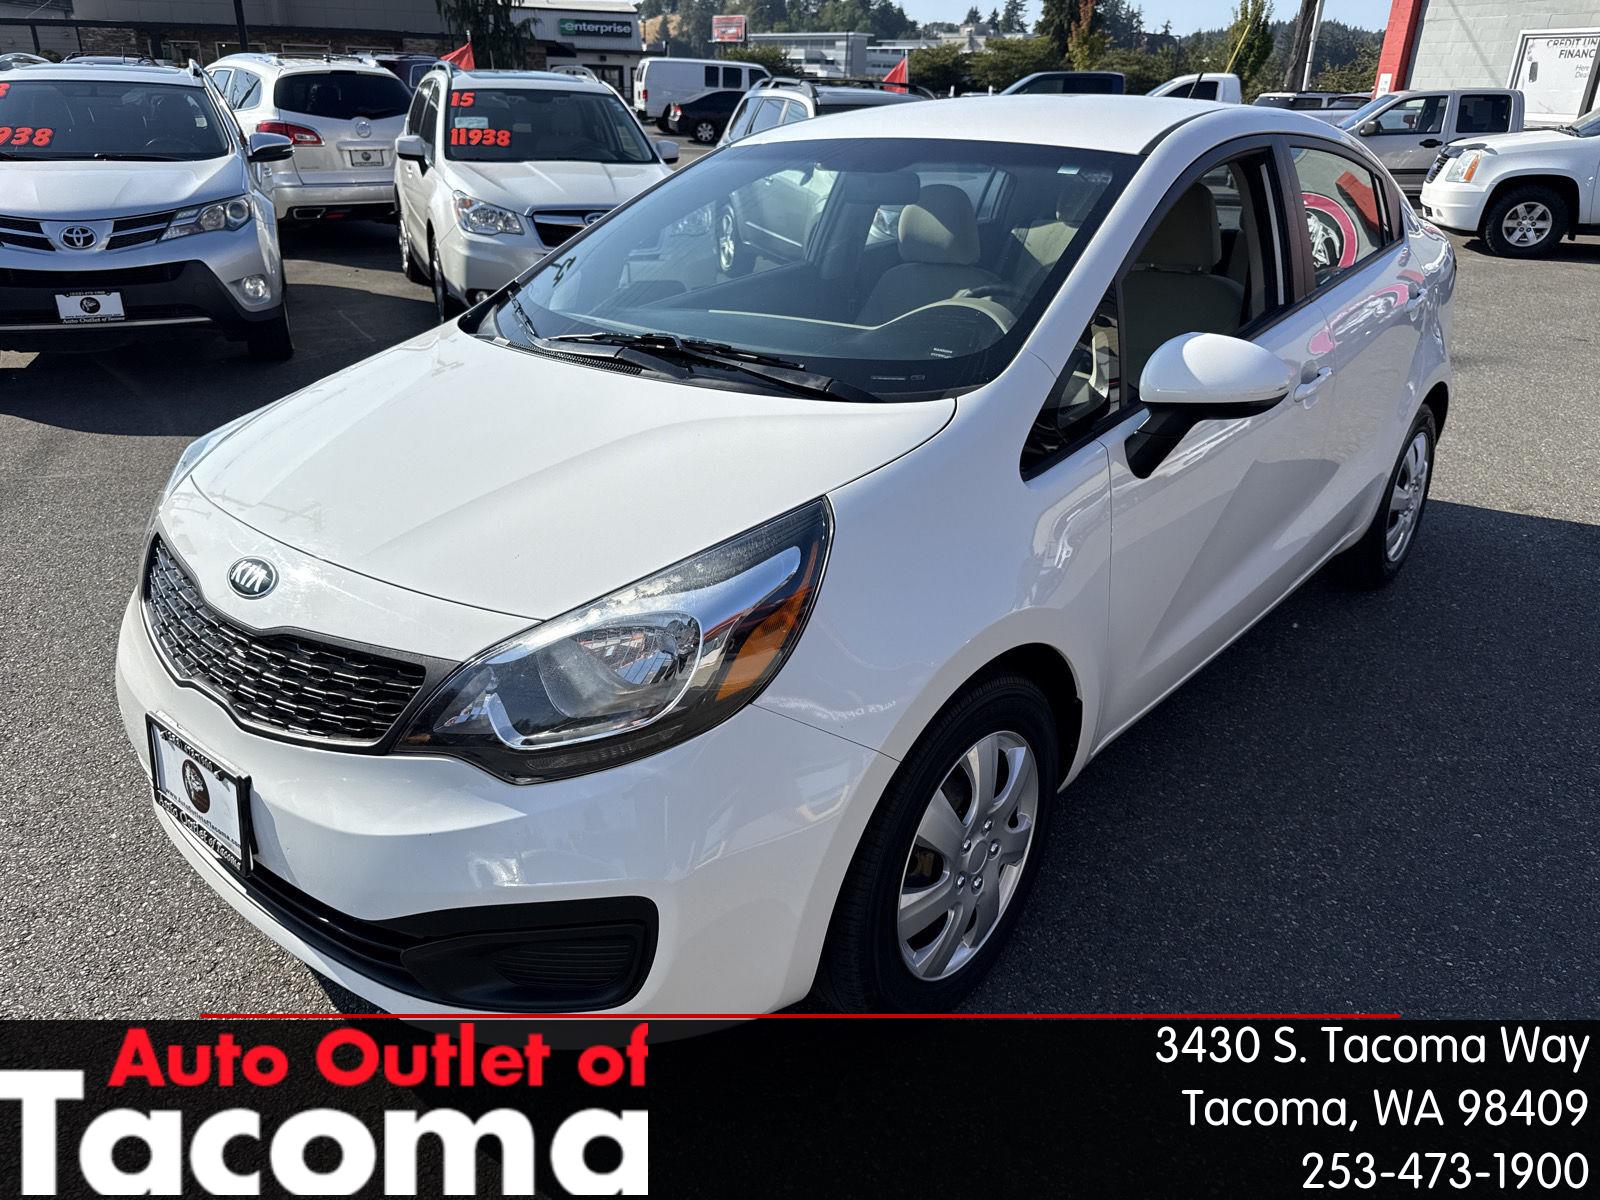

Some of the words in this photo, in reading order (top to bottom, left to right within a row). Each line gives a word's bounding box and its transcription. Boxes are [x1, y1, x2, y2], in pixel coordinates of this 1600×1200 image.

[561, 22, 632, 34] enterprise
[450, 91, 475, 107] 15
[450, 128, 511, 147] 11938
